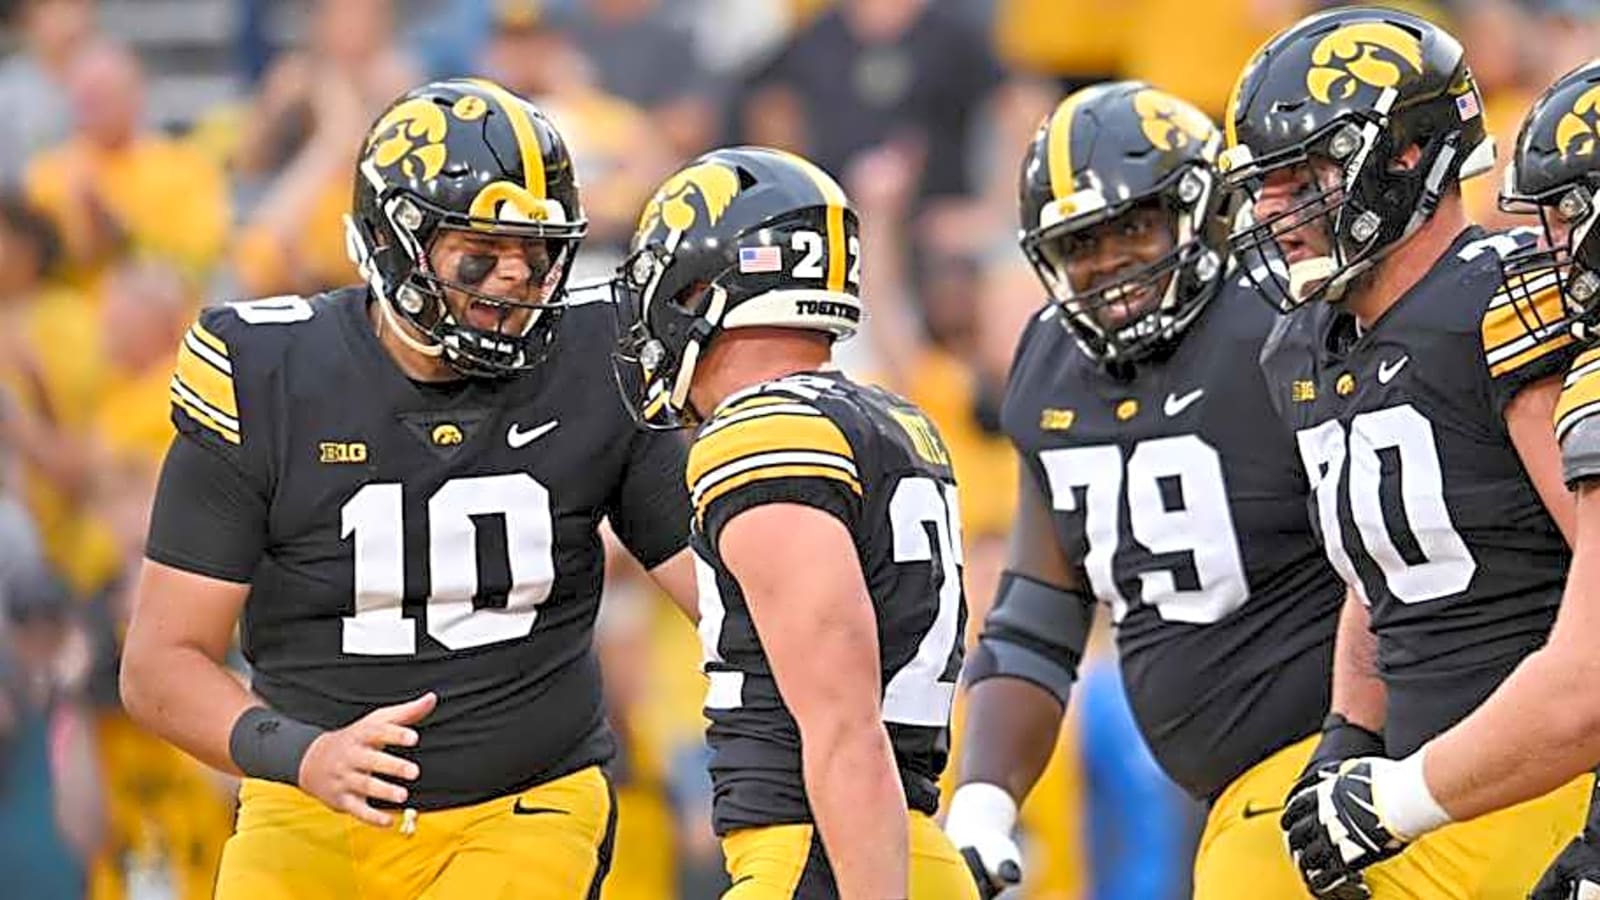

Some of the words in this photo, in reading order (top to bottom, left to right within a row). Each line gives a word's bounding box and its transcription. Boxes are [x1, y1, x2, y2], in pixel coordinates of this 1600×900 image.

[340, 472, 556, 655] 10
[1039, 434, 1249, 625] 79
[1296, 404, 1477, 607] 70
